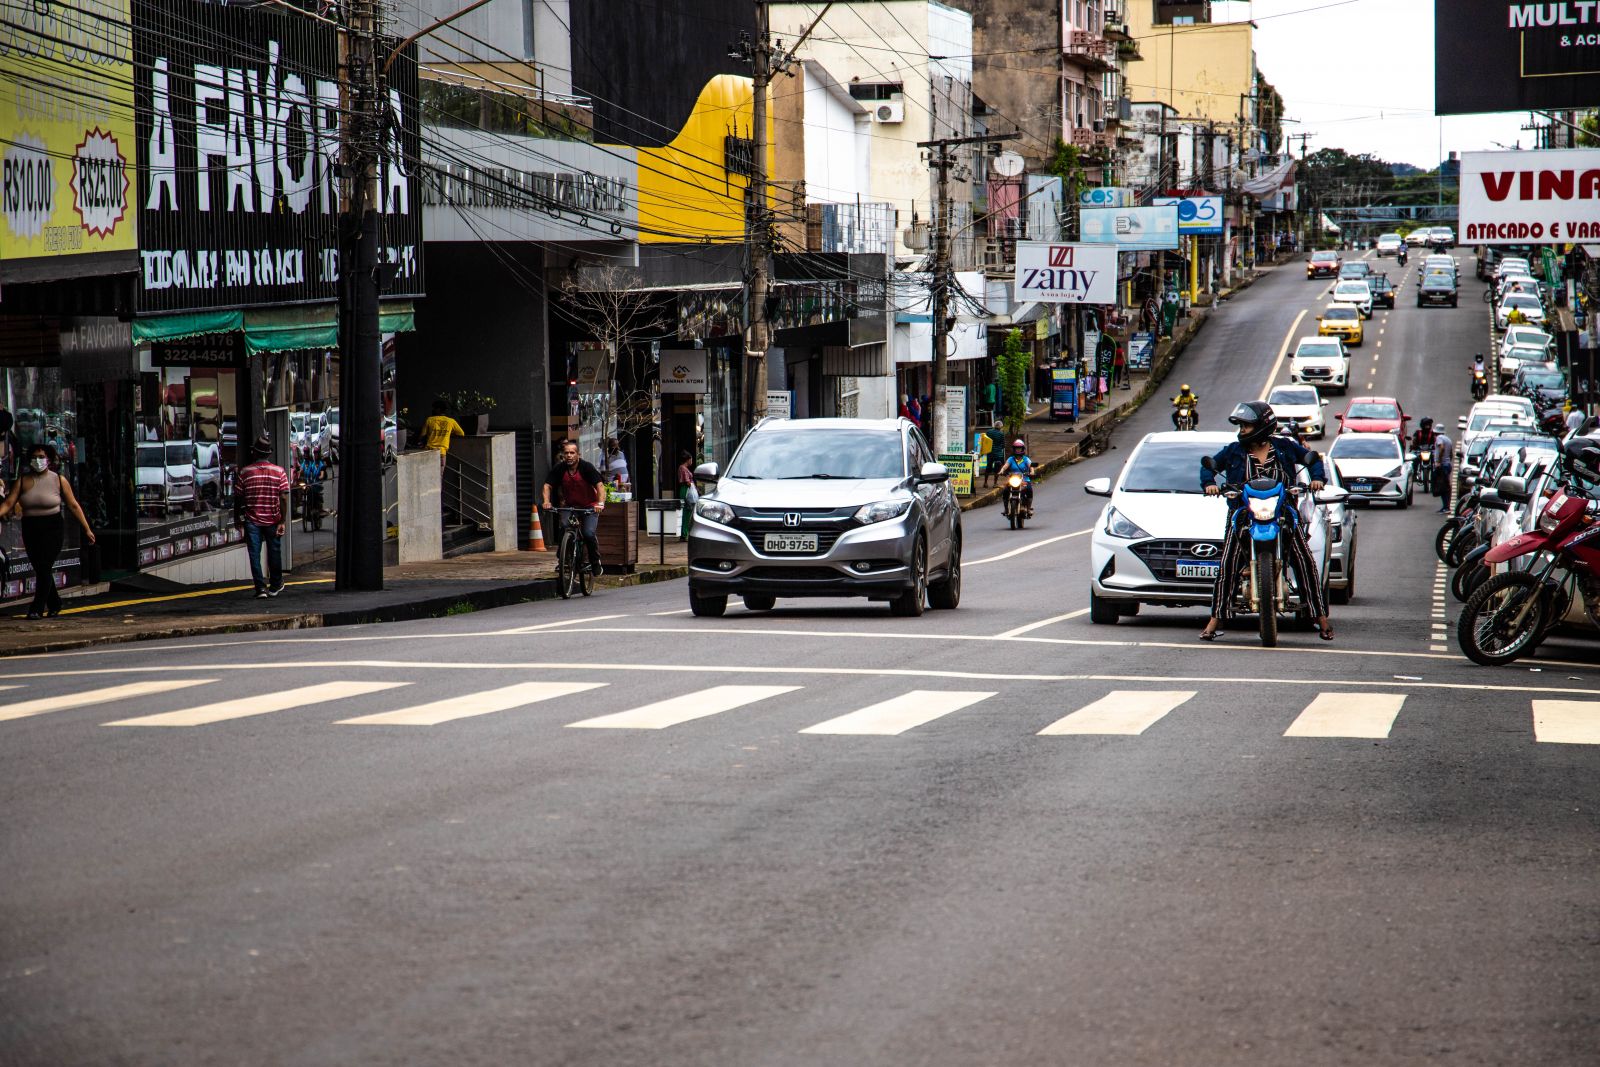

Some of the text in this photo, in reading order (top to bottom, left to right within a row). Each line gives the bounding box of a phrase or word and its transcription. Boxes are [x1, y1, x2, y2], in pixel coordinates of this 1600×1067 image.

[1560, 35, 1571, 46] &
[3, 154, 52, 221] R$10,00
[79, 153, 122, 216] R$25,00
[1467, 222, 1544, 240] ATACADO
[1550, 221, 1559, 239] E
[1022, 268, 1097, 301] zany
[80, 316, 130, 351] FAVORITA
[164, 349, 234, 362] 3224-4541
